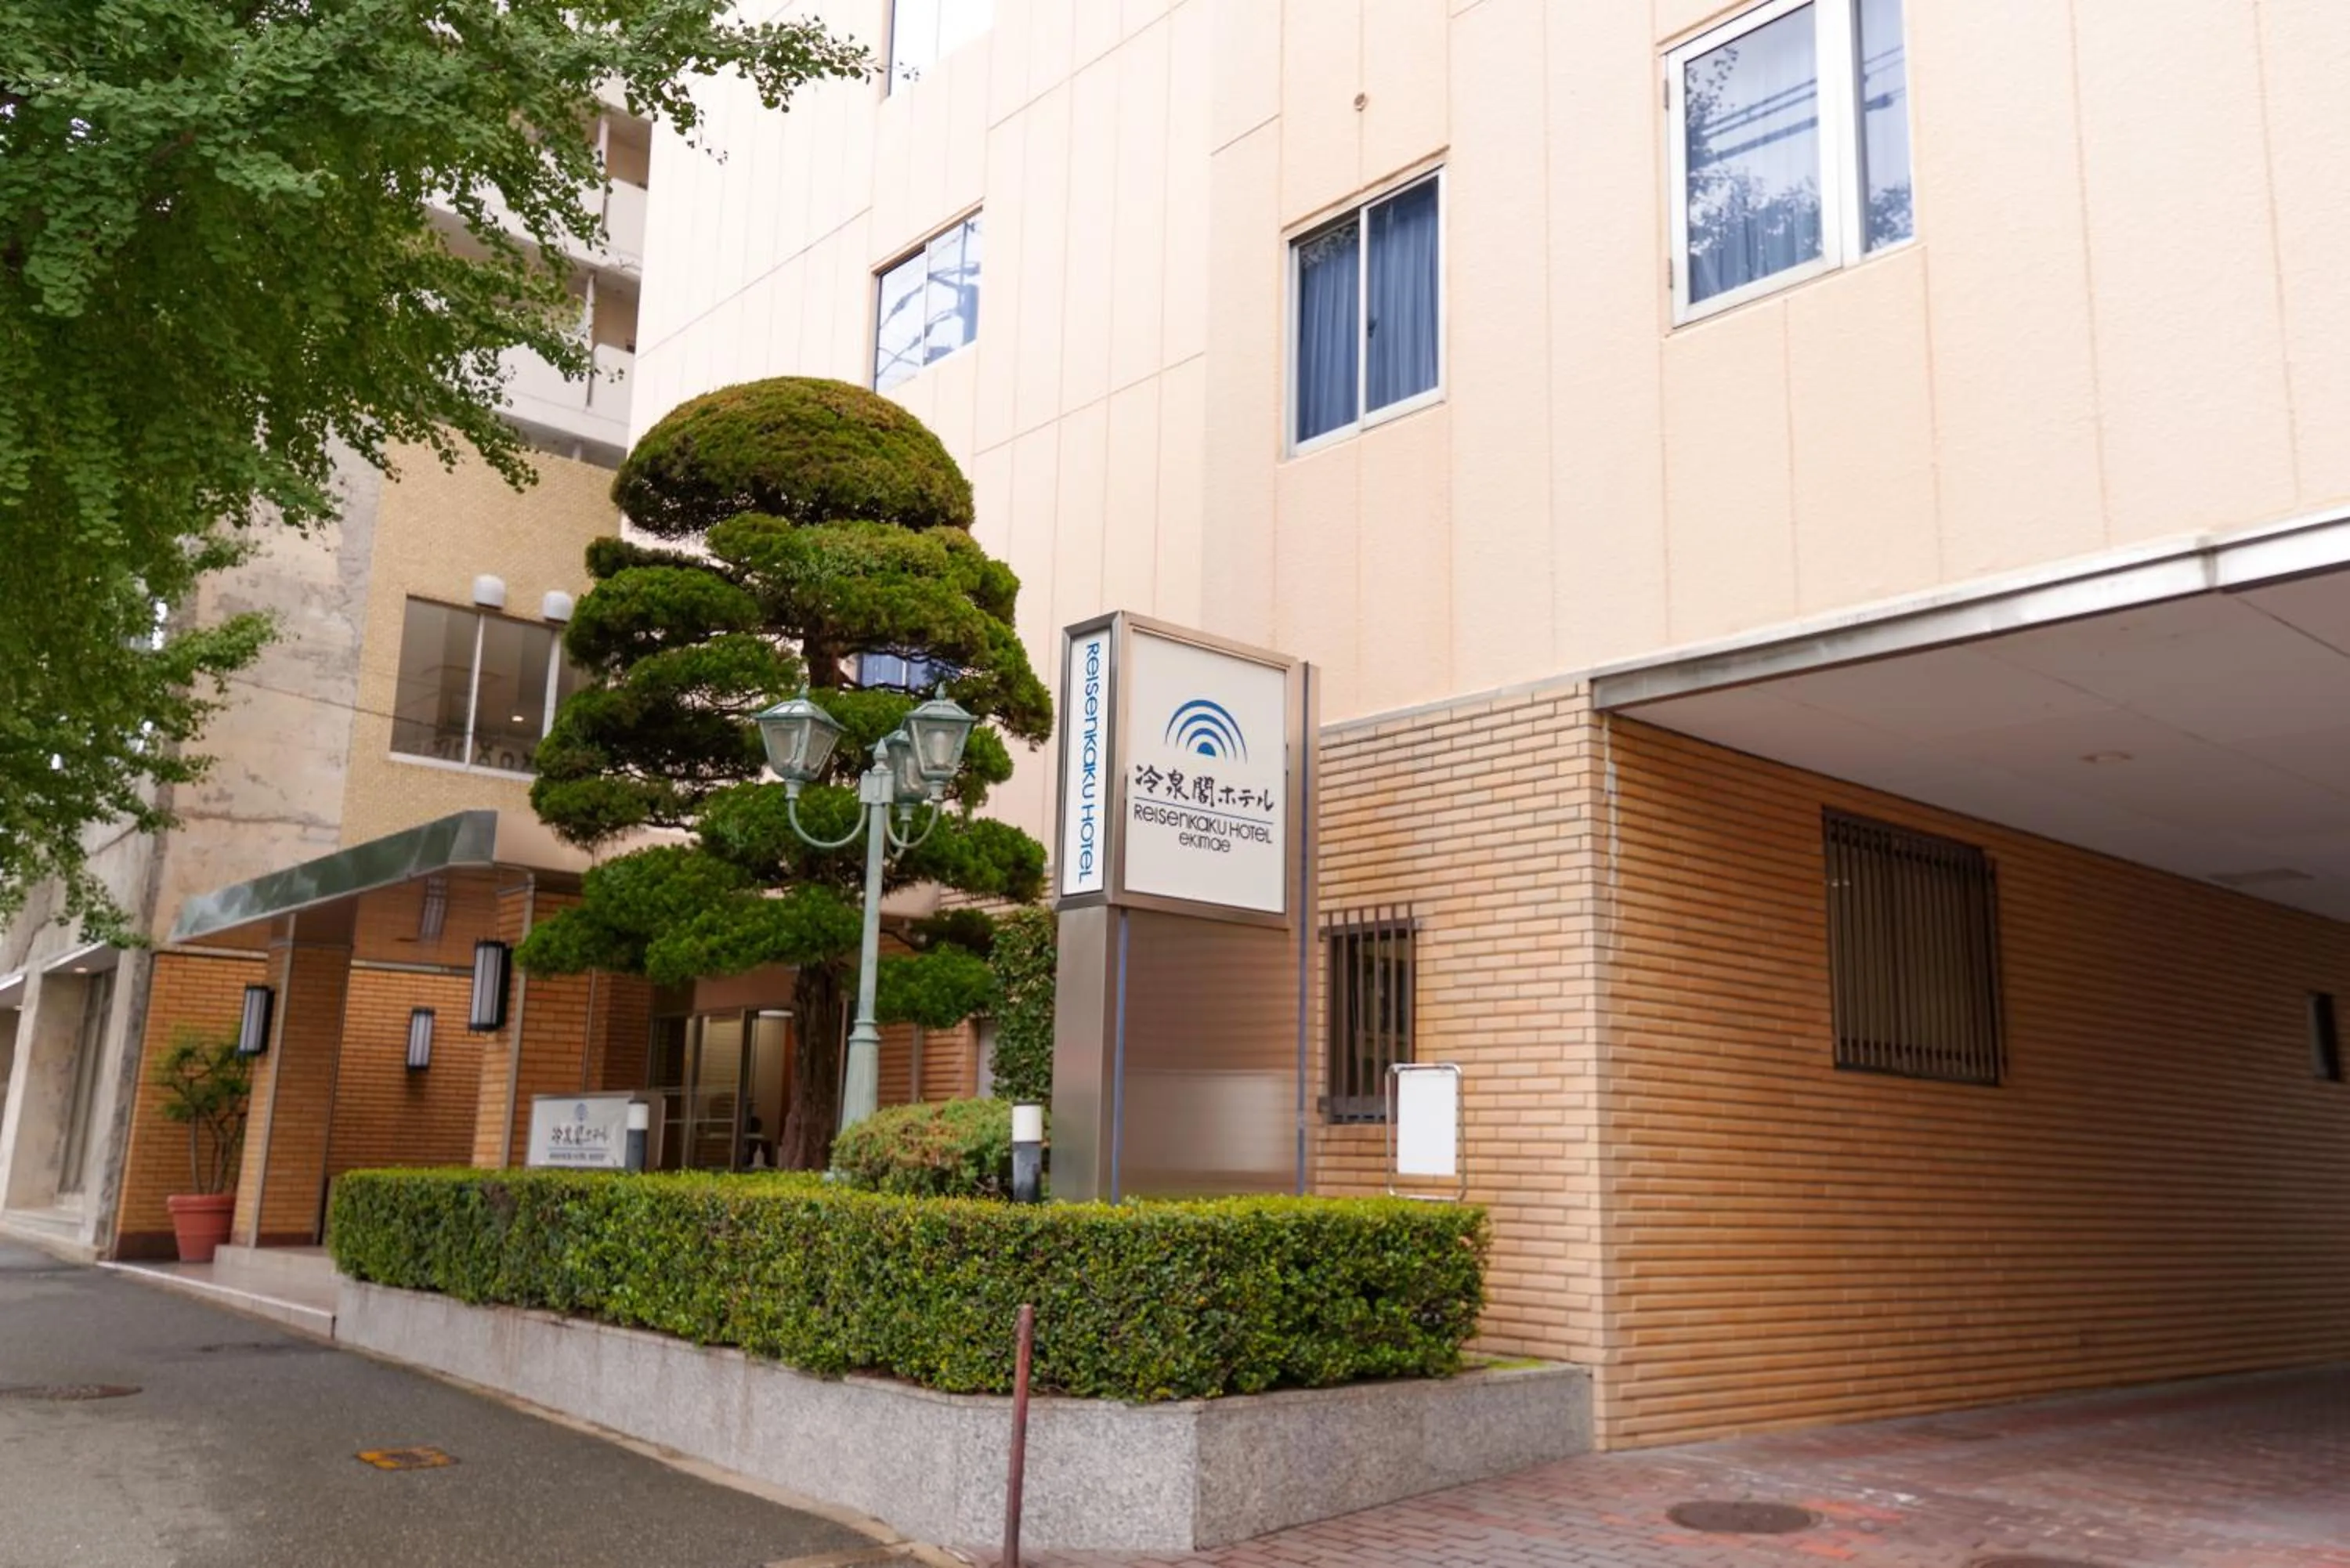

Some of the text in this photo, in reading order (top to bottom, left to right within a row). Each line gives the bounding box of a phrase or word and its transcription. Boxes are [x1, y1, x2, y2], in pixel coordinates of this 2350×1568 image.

[1135, 764, 1274, 811] 冷泉閣ホテル
